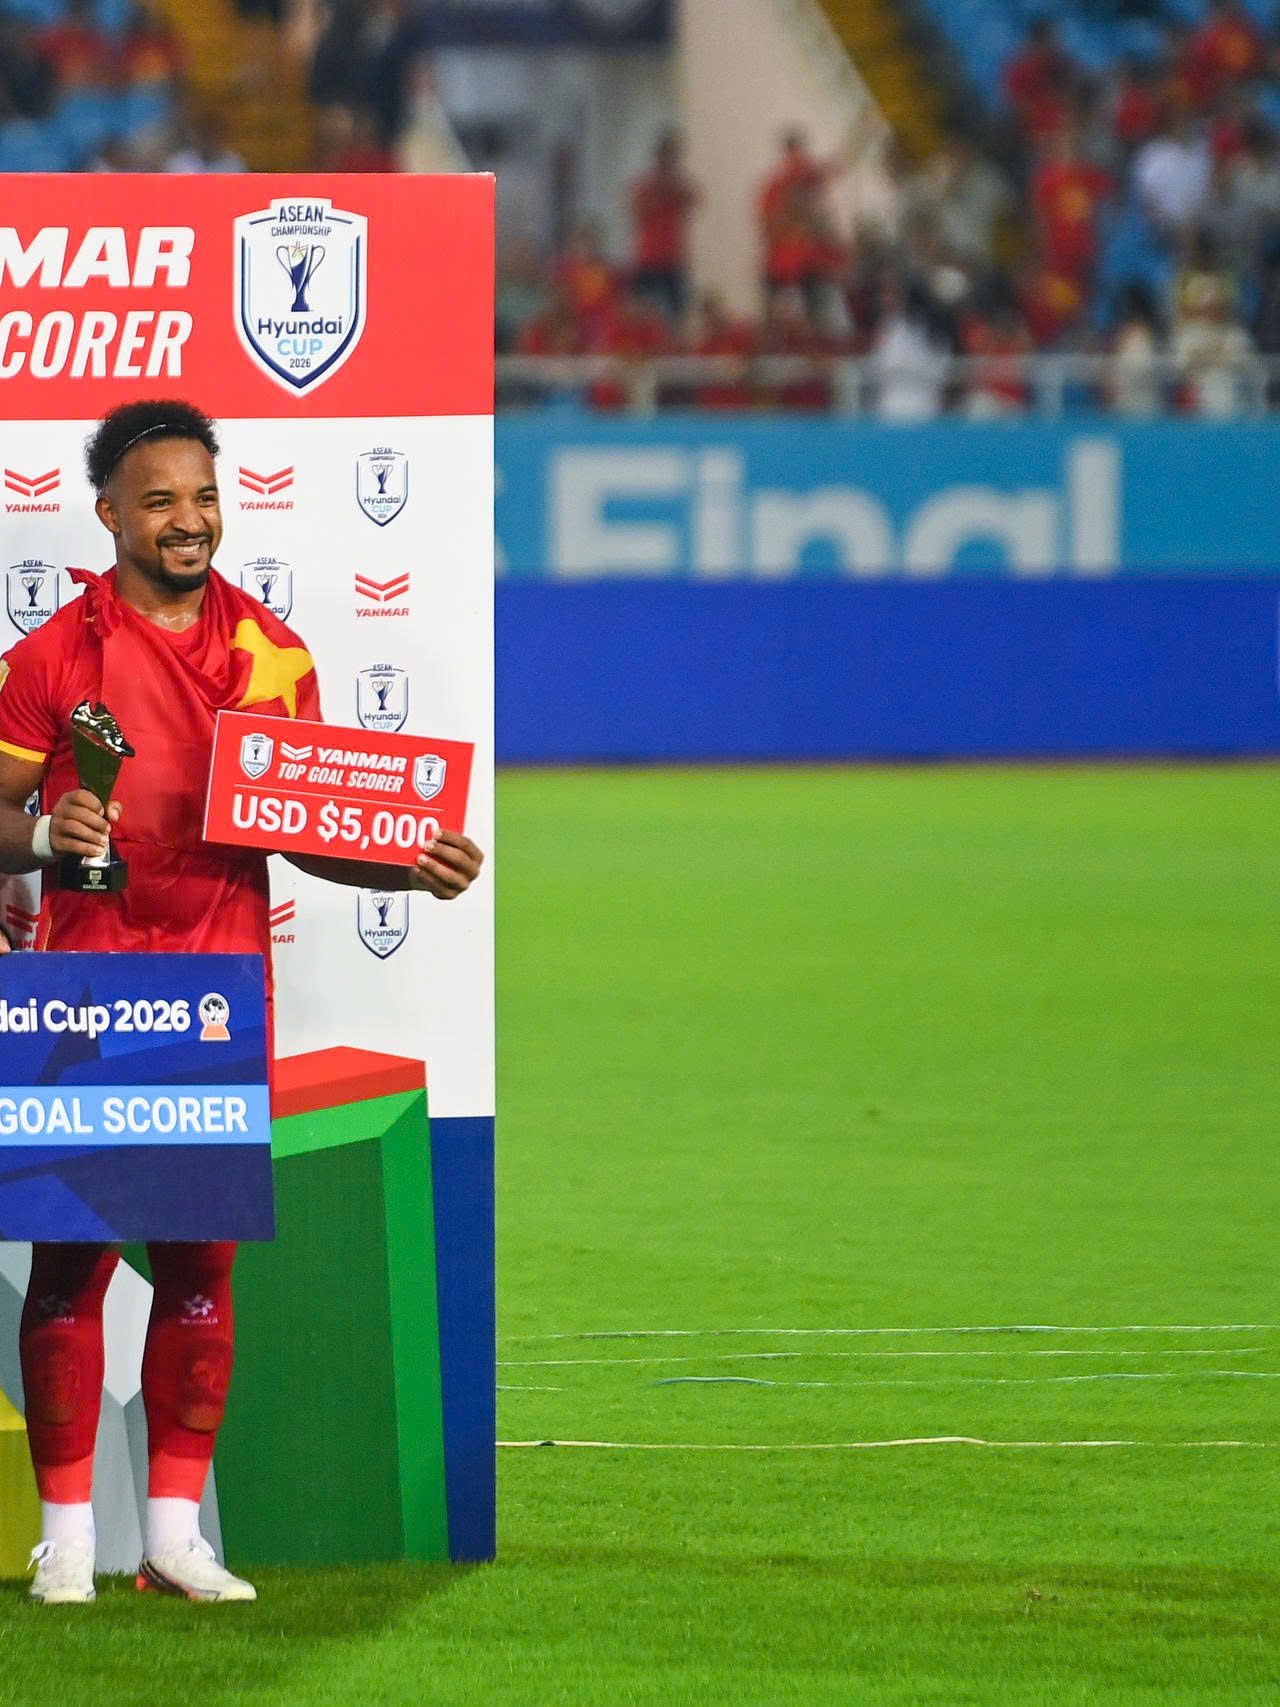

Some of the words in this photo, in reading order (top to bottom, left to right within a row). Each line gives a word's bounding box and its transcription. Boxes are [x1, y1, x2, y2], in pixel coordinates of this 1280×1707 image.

[279, 205, 324, 223] ASEAN
[271, 225, 332, 237] CHAMPIONSHIP
[258, 315, 342, 339] Hyundai
[277, 338, 323, 356] CUP
[289, 358, 311, 368] 2026
[240, 501, 293, 510] YANMAR
[364, 496, 401, 505] Hyundai
[6, 504, 60, 512] YANMAR
[373, 505, 392, 513] CUP
[547, 437, 1120, 580] Final
[14, 608, 52, 618] Hyundai
[356, 608, 409, 617] YANMAR
[23, 618, 43, 626] CUP
[365, 712, 401, 722] Hyundai
[317, 747, 408, 772] YANMAR
[278, 762, 307, 780] TOP
[308, 766, 345, 785] GOAL
[346, 770, 405, 793] SCORER
[232, 793, 308, 834] USD
[317, 800, 441, 850] $5,000
[365, 928, 402, 938] Hyundai
[43, 999, 110, 1039] Cup
[114, 999, 192, 1032] 2026
[103, 1096, 249, 1134] SCORER
